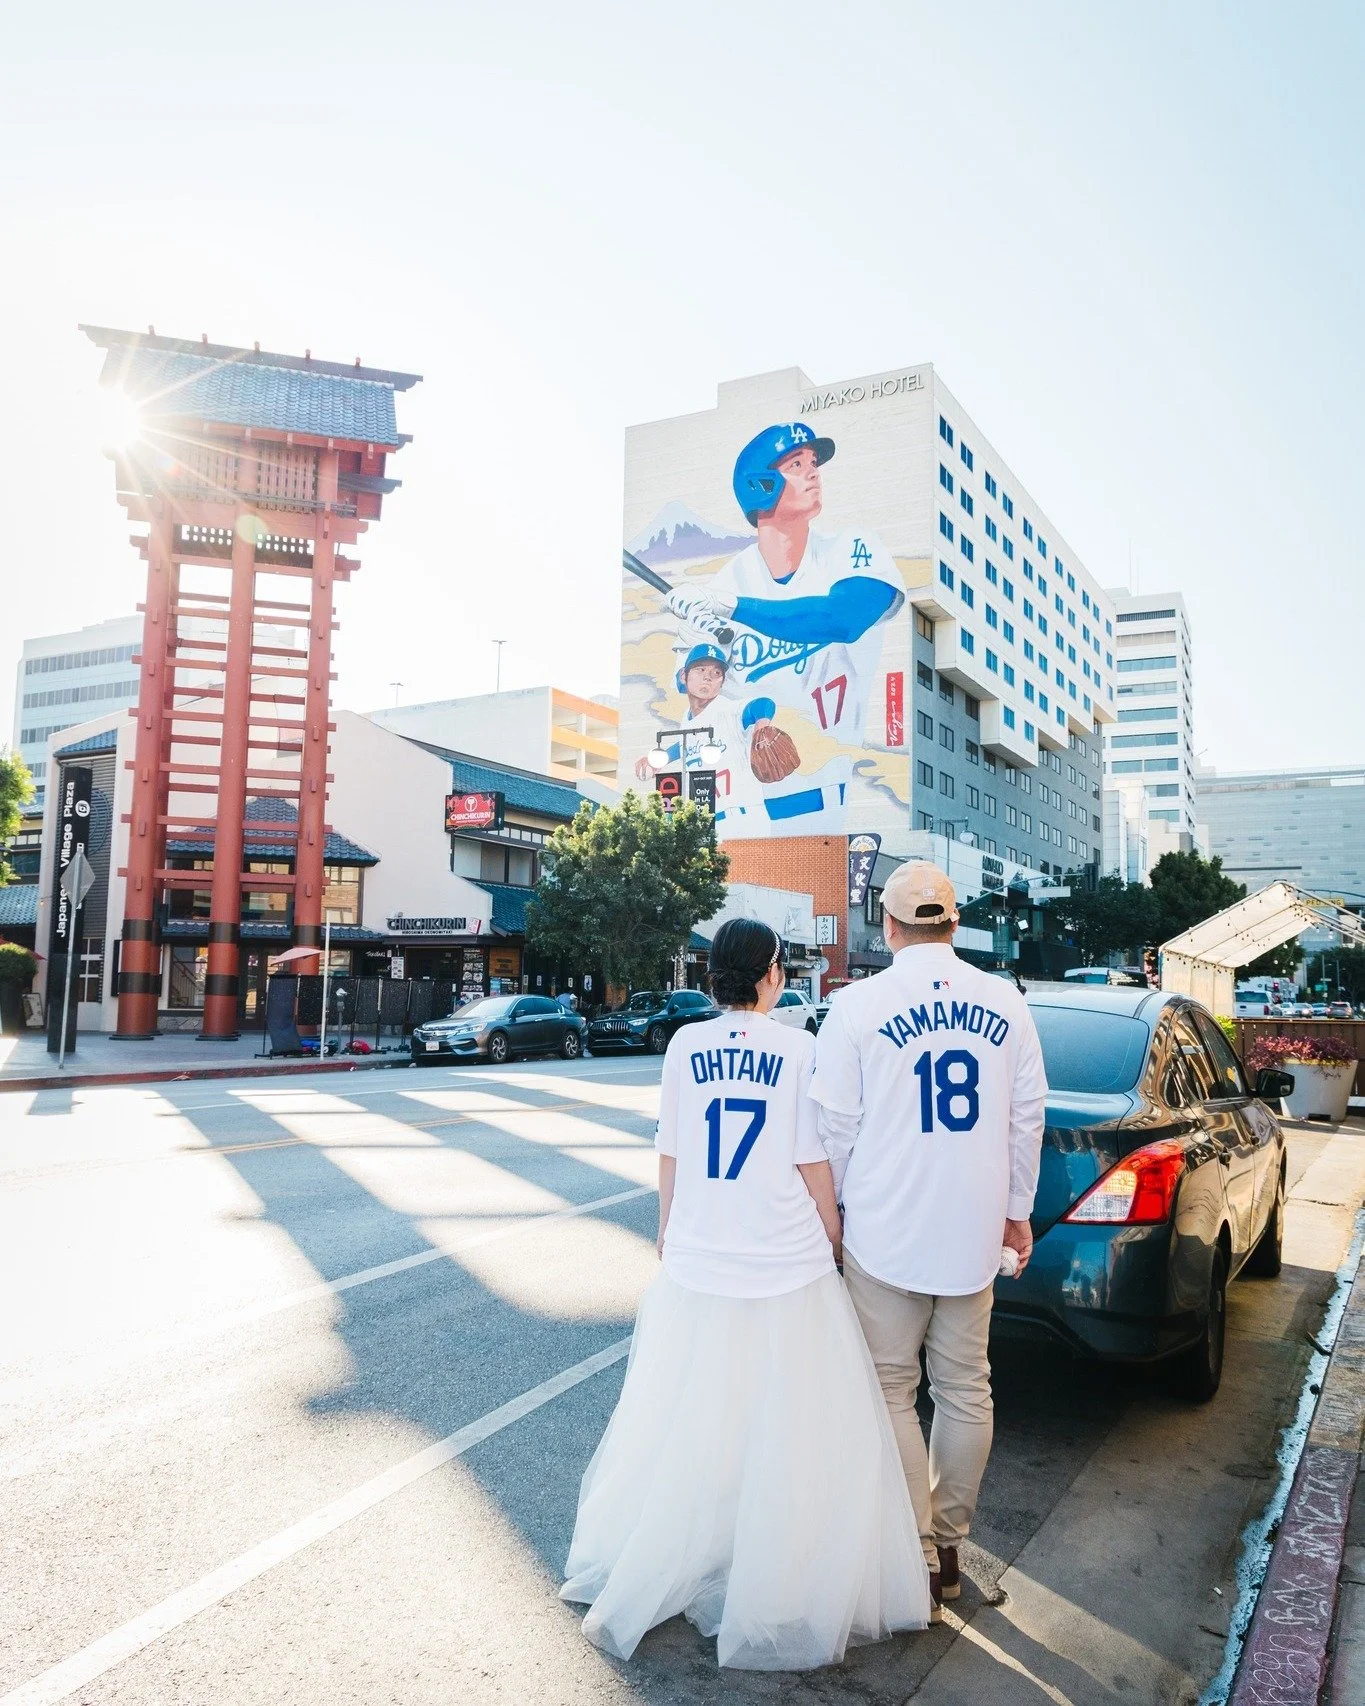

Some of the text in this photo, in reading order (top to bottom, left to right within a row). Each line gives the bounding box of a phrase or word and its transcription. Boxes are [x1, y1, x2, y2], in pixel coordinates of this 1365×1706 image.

[800, 374, 925, 414] MIYAKO HOTEL
[789, 423, 808, 444] LA
[851, 537, 872, 568] LA
[811, 674, 848, 731] 17
[696, 788, 710, 796] Only
[56, 781, 75, 938] Japane Village Plaza
[386, 917, 467, 930] CHINCHIKURIN
[878, 1000, 1009, 1049] YAMAMOTO
[690, 1048, 784, 1087] OHTANI
[914, 1050, 980, 1133] 18
[705, 1098, 767, 1180] 17
